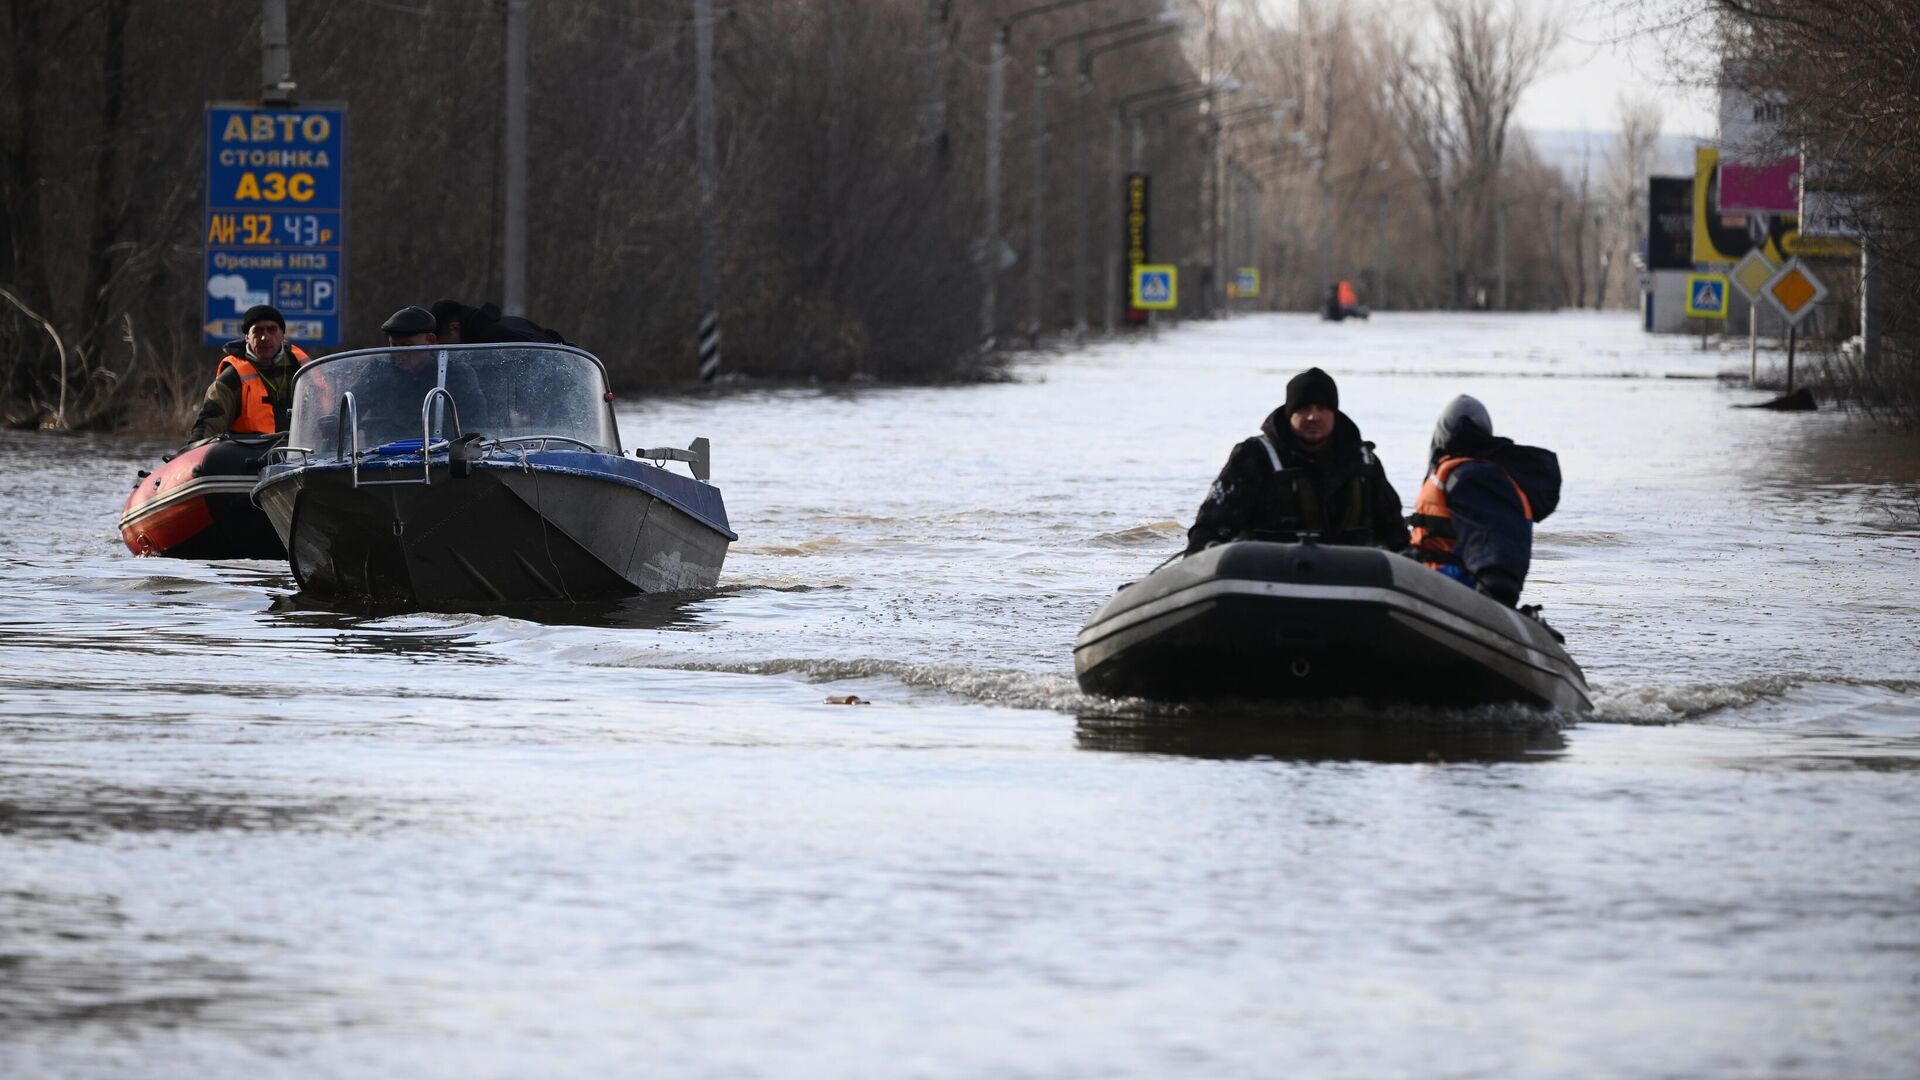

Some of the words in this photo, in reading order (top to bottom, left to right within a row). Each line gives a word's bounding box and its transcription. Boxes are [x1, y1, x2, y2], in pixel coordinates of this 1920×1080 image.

[223, 114, 330, 142] АВТО
[220, 150, 329, 167] СТОЯНКА
[235, 172, 315, 201] АЗС
[214, 252, 283, 271] Орский
[288, 253, 326, 269] НПЗ
